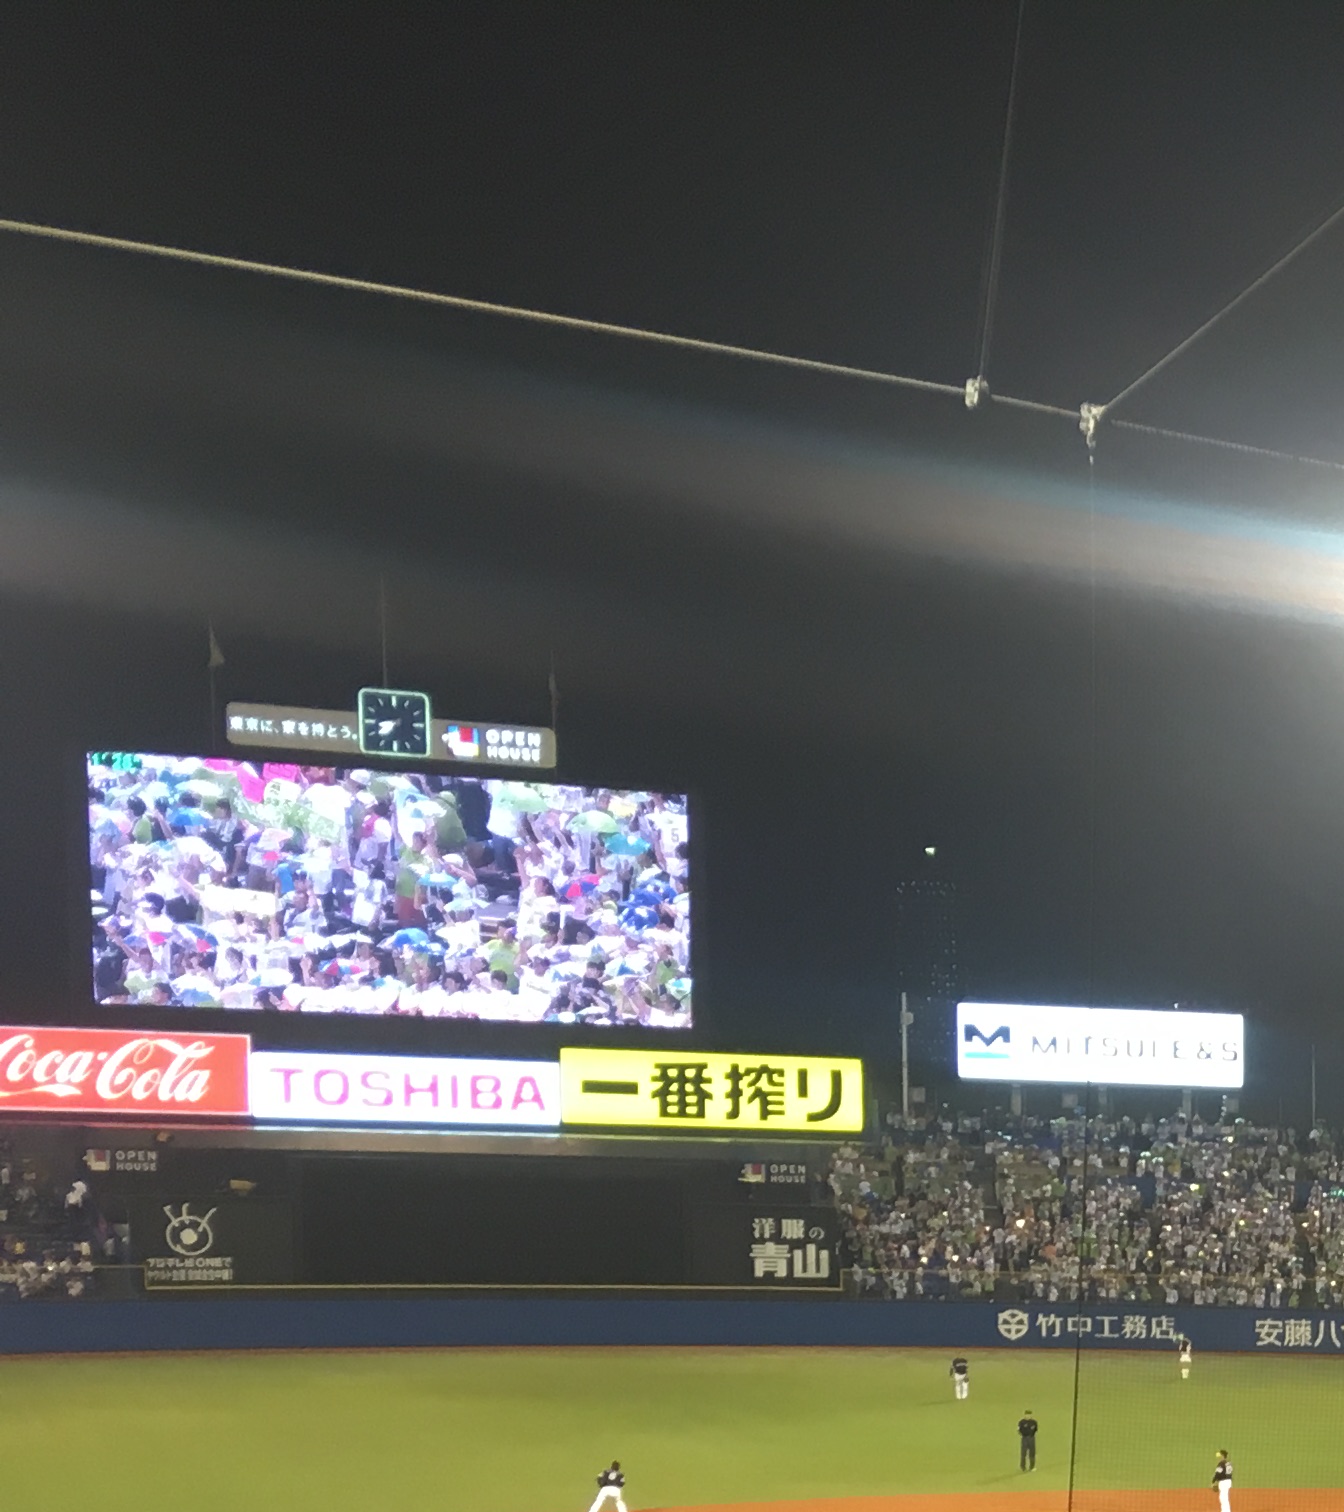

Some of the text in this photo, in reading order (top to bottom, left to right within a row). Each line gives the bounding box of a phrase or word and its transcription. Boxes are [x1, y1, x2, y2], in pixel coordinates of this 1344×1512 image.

[485, 728, 541, 747] OPEN
[486, 746, 541, 762] HOUSE
[0, 1033, 214, 1102] Coca-Cola
[270, 1067, 546, 1111] TOSHIBA
[581, 1062, 842, 1122] 一番搾り
[115, 1149, 158, 1161] OPEN
[116, 1161, 158, 1171] HOUSE
[769, 1163, 806, 1174] OPEN
[770, 1175, 806, 1183] HOUSE
[752, 1218, 825, 1240] 洋服の
[749, 1242, 830, 1278] 青山
[1035, 1313, 1176, 1339] 竹中工務店
